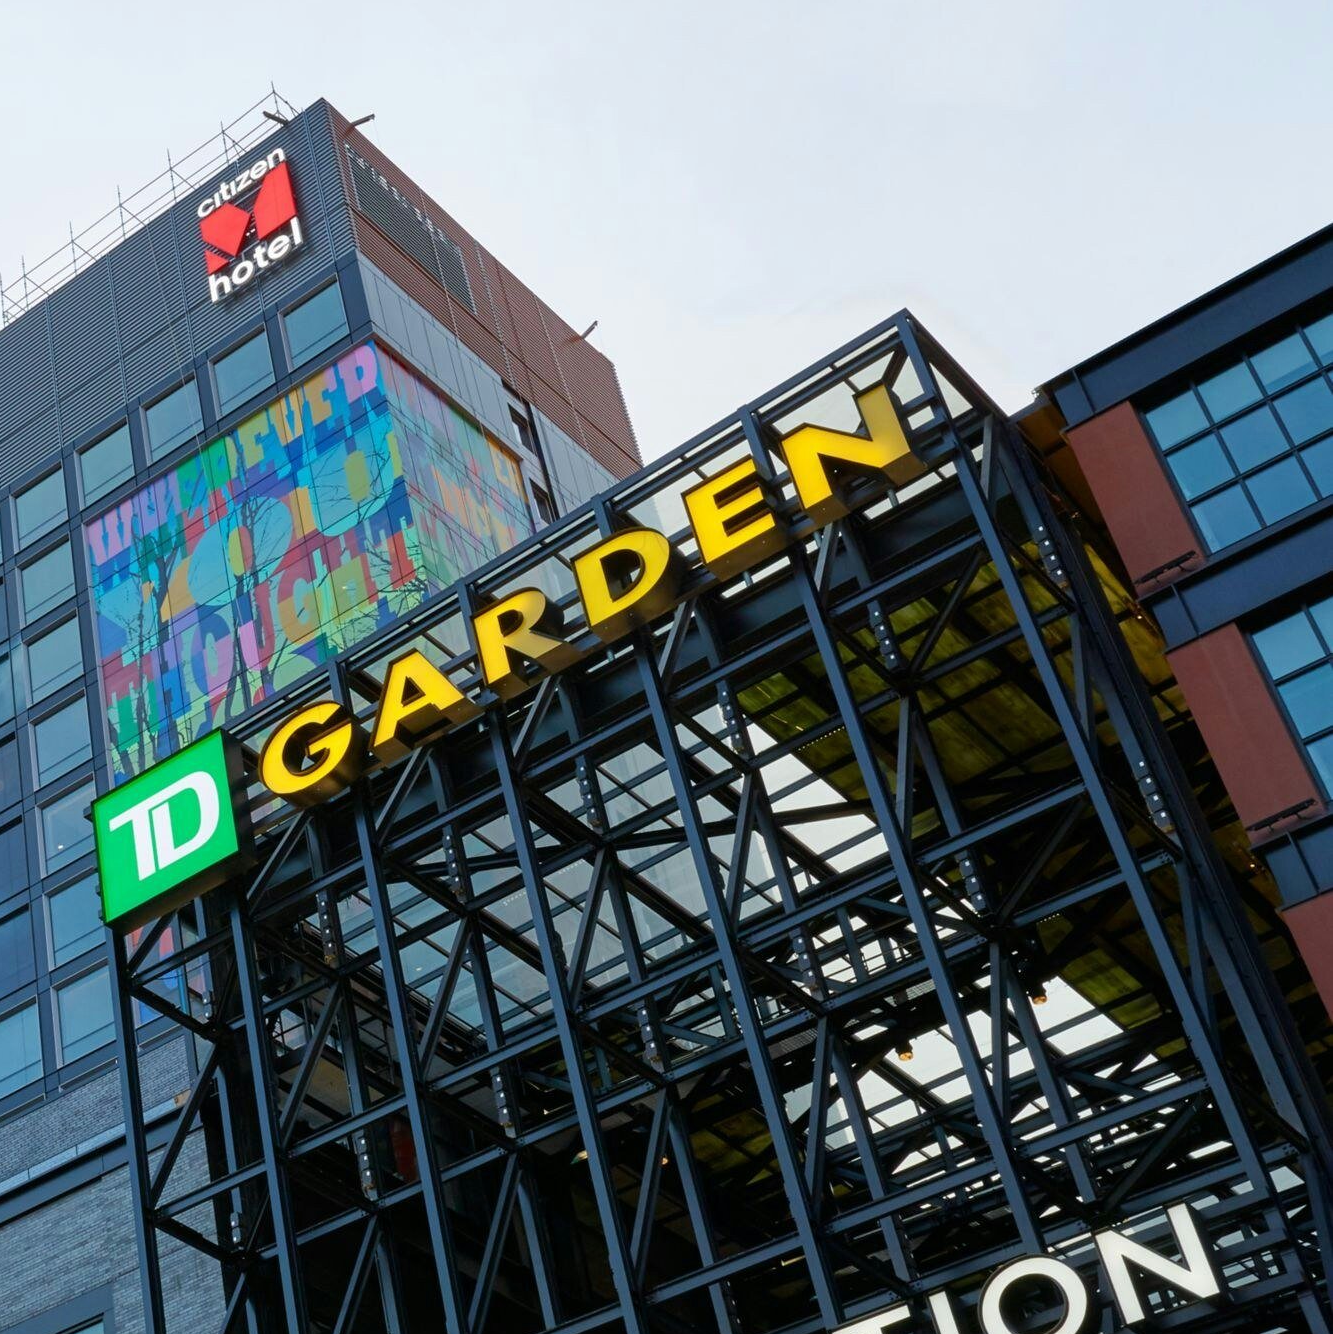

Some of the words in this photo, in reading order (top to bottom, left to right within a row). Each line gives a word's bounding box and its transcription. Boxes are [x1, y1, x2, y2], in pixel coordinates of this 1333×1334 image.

[197, 147, 286, 218] citizen
[208, 216, 303, 302] hotel
[95, 414, 399, 668] YOU
[105, 491, 423, 755] THOUGHT
[109, 771, 219, 881] TD
[257, 381, 925, 803] GARDEN
